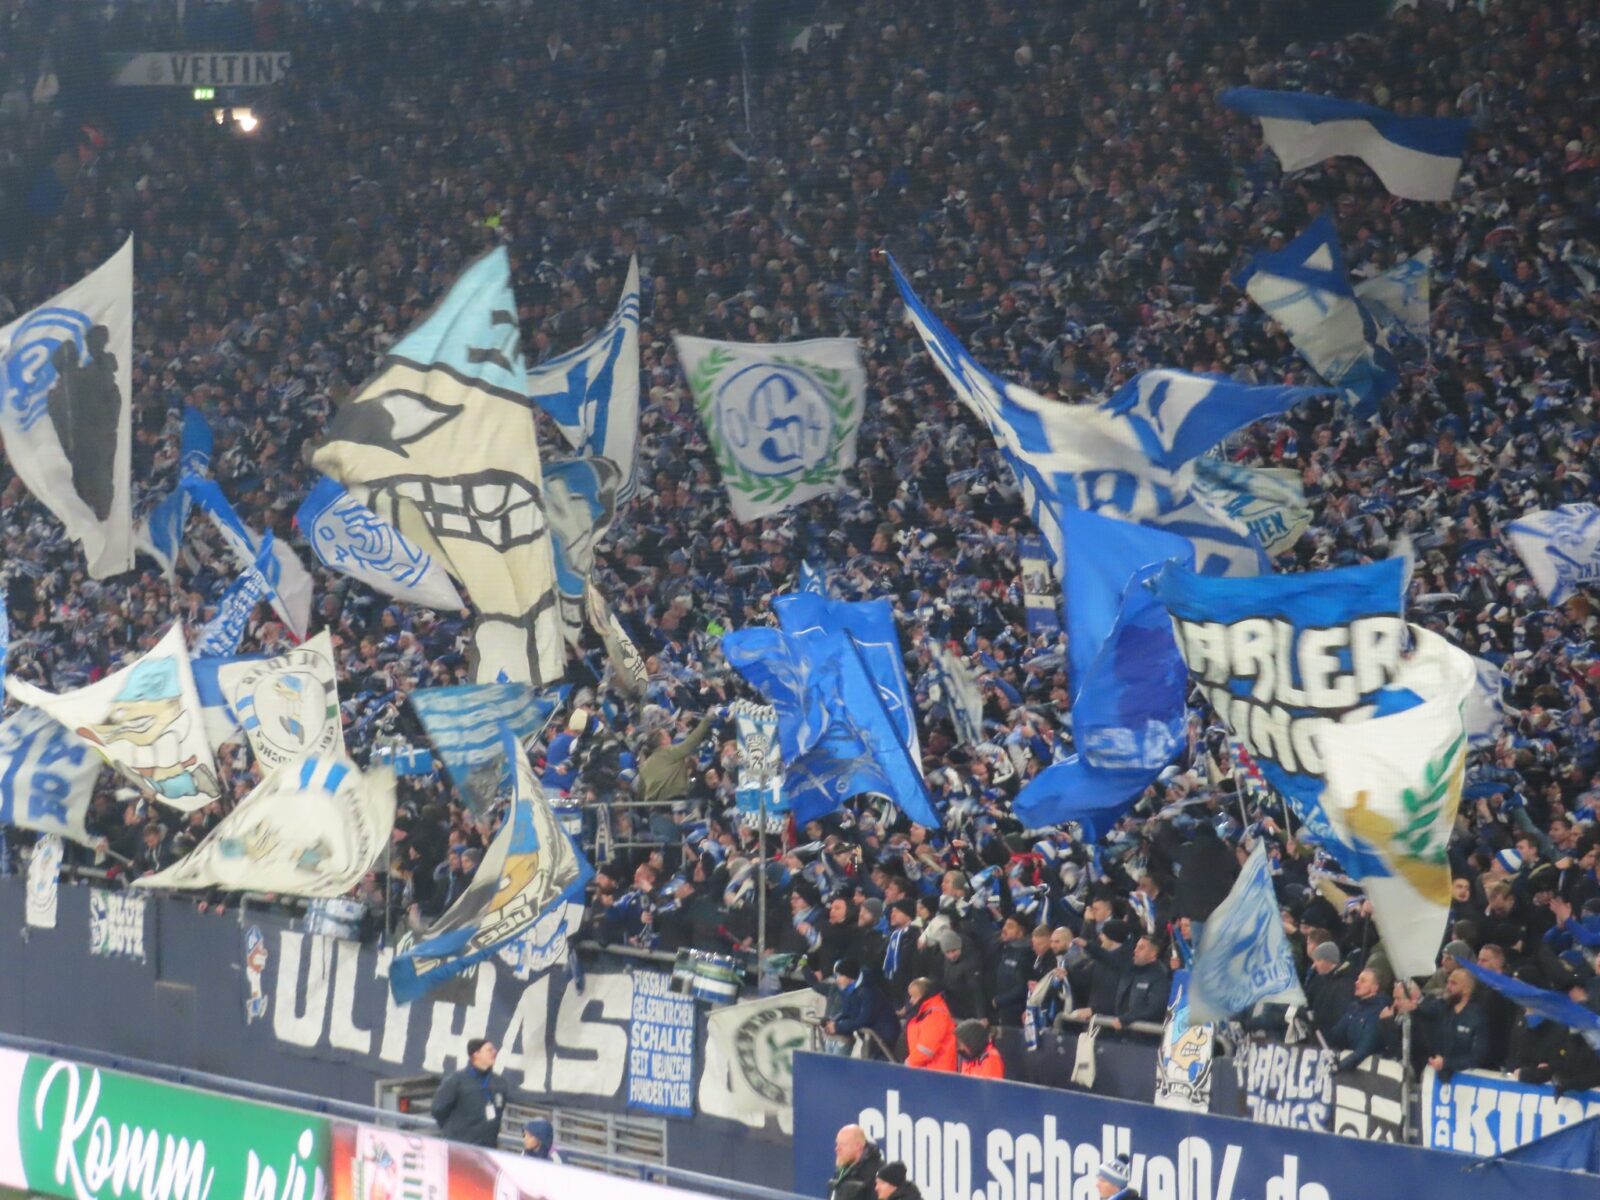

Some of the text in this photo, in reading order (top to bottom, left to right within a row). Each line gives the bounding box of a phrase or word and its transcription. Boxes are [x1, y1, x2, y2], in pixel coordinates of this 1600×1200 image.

[170, 55, 291, 84] VELTINS
[272, 931, 629, 1097] ULTRAS
[632, 994, 695, 1027] GELSENKIRCHEN
[630, 1021, 693, 1055] SCHALKE
[630, 1049, 649, 1077] SEIT
[34, 1060, 215, 1200] Komm
[1452, 1083, 1600, 1158] KUR
